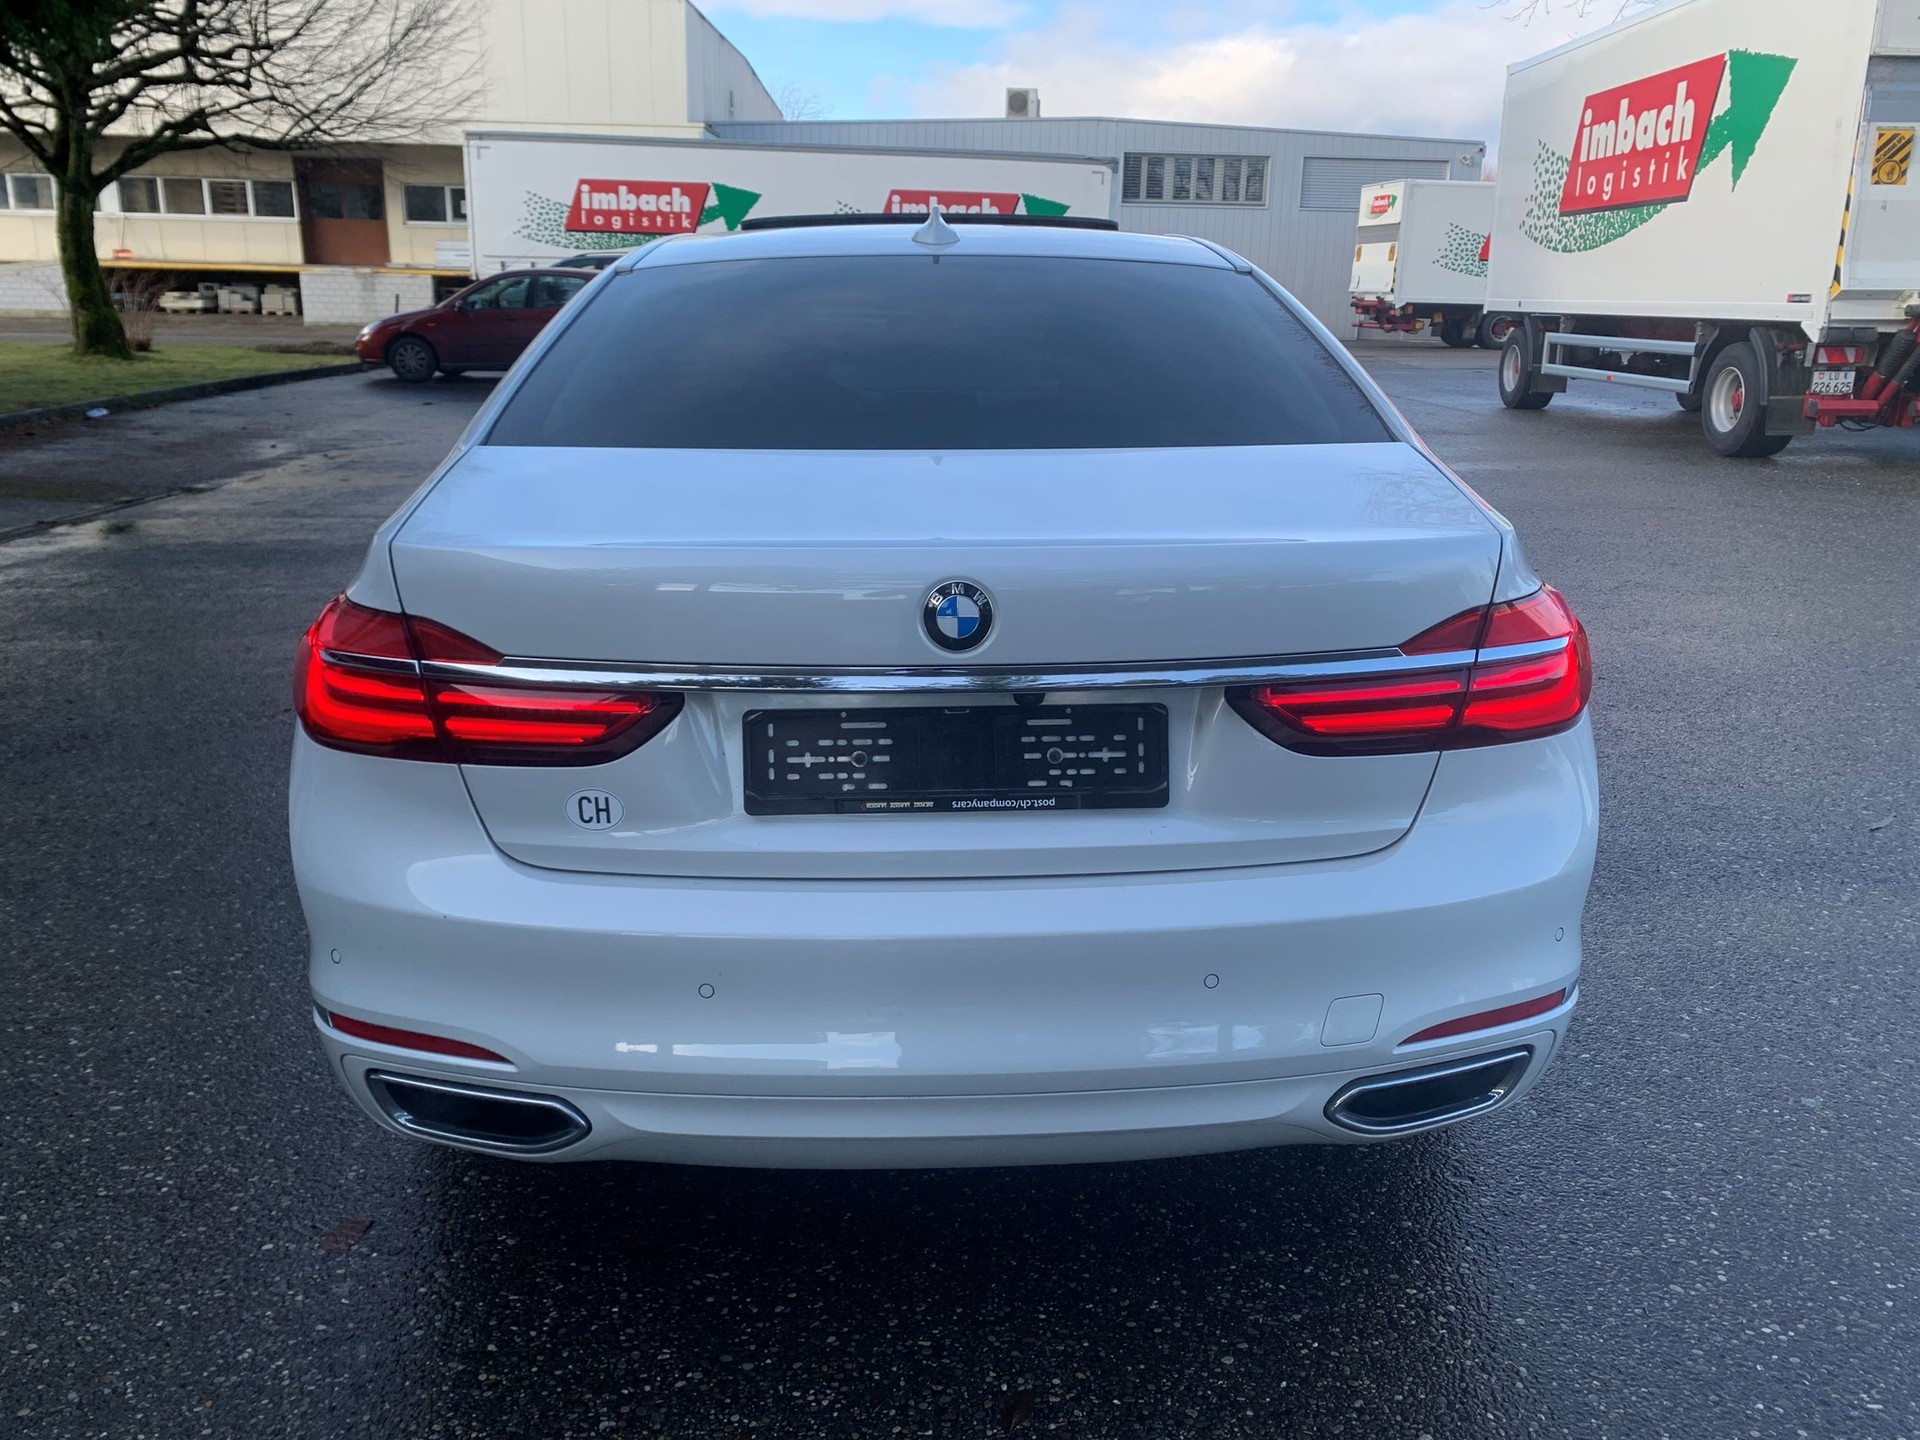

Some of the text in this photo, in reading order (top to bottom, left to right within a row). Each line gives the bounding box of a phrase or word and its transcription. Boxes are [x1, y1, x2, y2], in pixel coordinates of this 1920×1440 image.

[1580, 80, 1695, 162] imbach
[1575, 146, 1689, 200] logistik
[580, 184, 691, 213] imbach
[581, 209, 692, 229] logistik
[1812, 382, 1852, 393] 226 625
[1829, 372, 1839, 380] LU
[929, 583, 987, 606] BMW
[578, 796, 611, 823] CH
[952, 798, 1056, 809] post.ch/companycars
